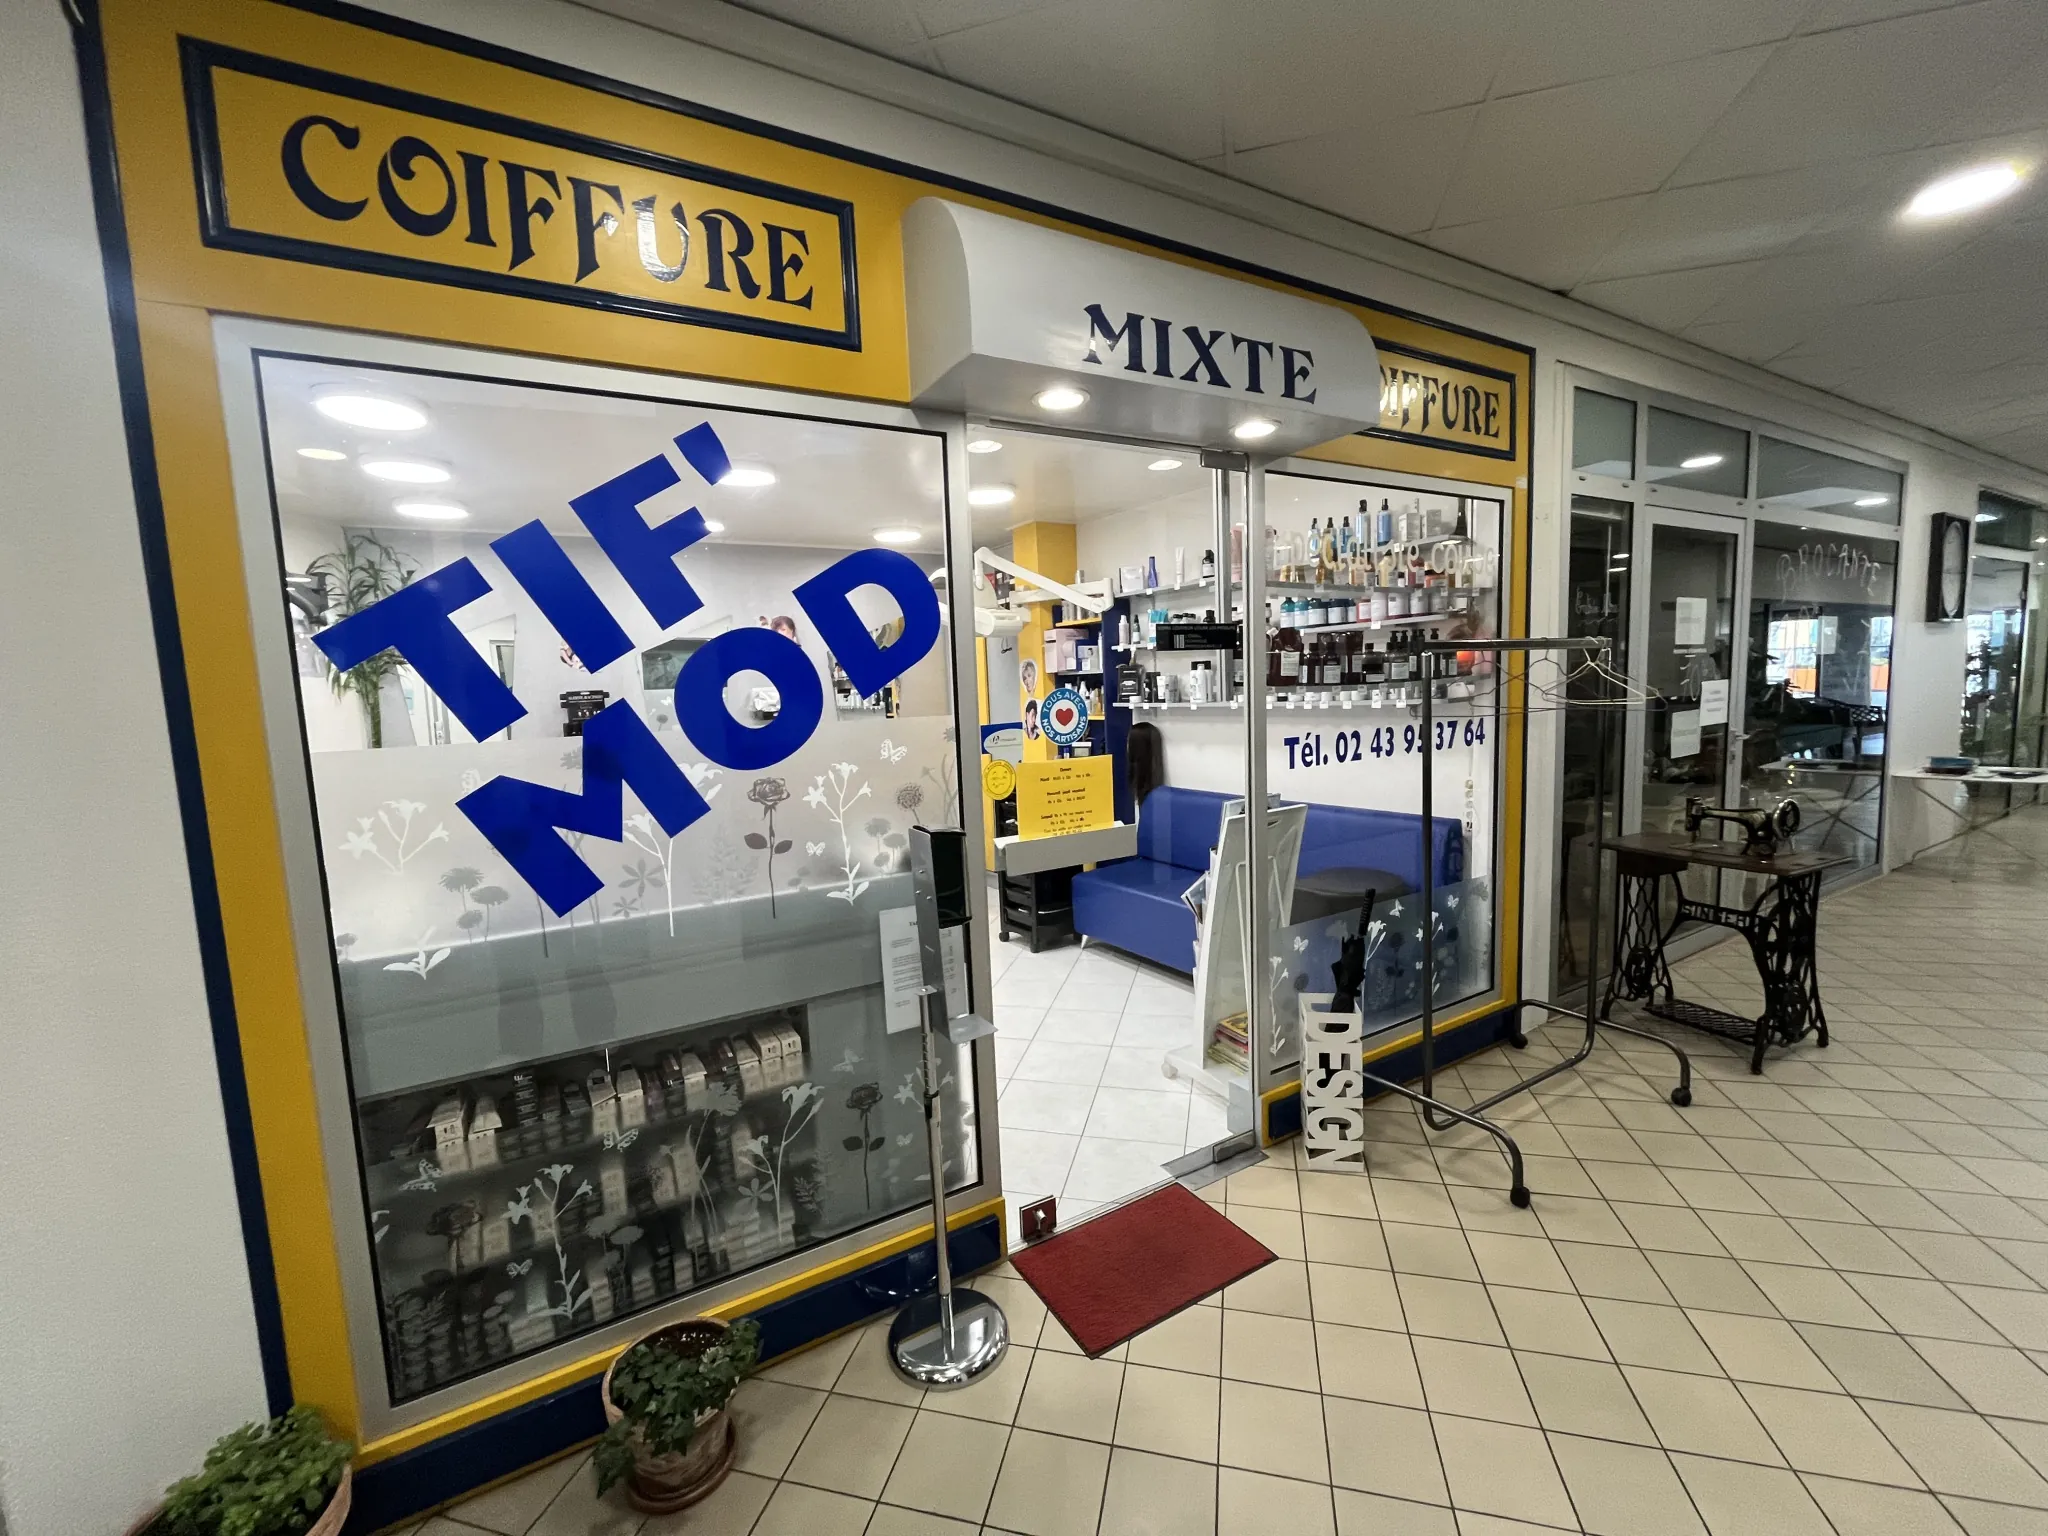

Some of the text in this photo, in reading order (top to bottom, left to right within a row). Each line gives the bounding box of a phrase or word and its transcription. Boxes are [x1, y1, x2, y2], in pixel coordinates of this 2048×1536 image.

[281, 114, 814, 311] COIFFURE
[1083, 303, 1318, 406] MIXTE
[311, 421, 732, 743] TIF'
[455, 548, 942, 917] MOD
[1042, 691, 1084, 713] TOUS AVEC
[1042, 715, 1087, 743] NOS ARTISANS
[1284, 732, 1329, 769] Tél.
[1335, 730, 1362, 763] 02
[1370, 726, 1395, 758] 43
[1435, 720, 1458, 750] 37
[1464, 717, 1486, 747] 64
[1305, 1012, 1365, 1172] DESIGN
